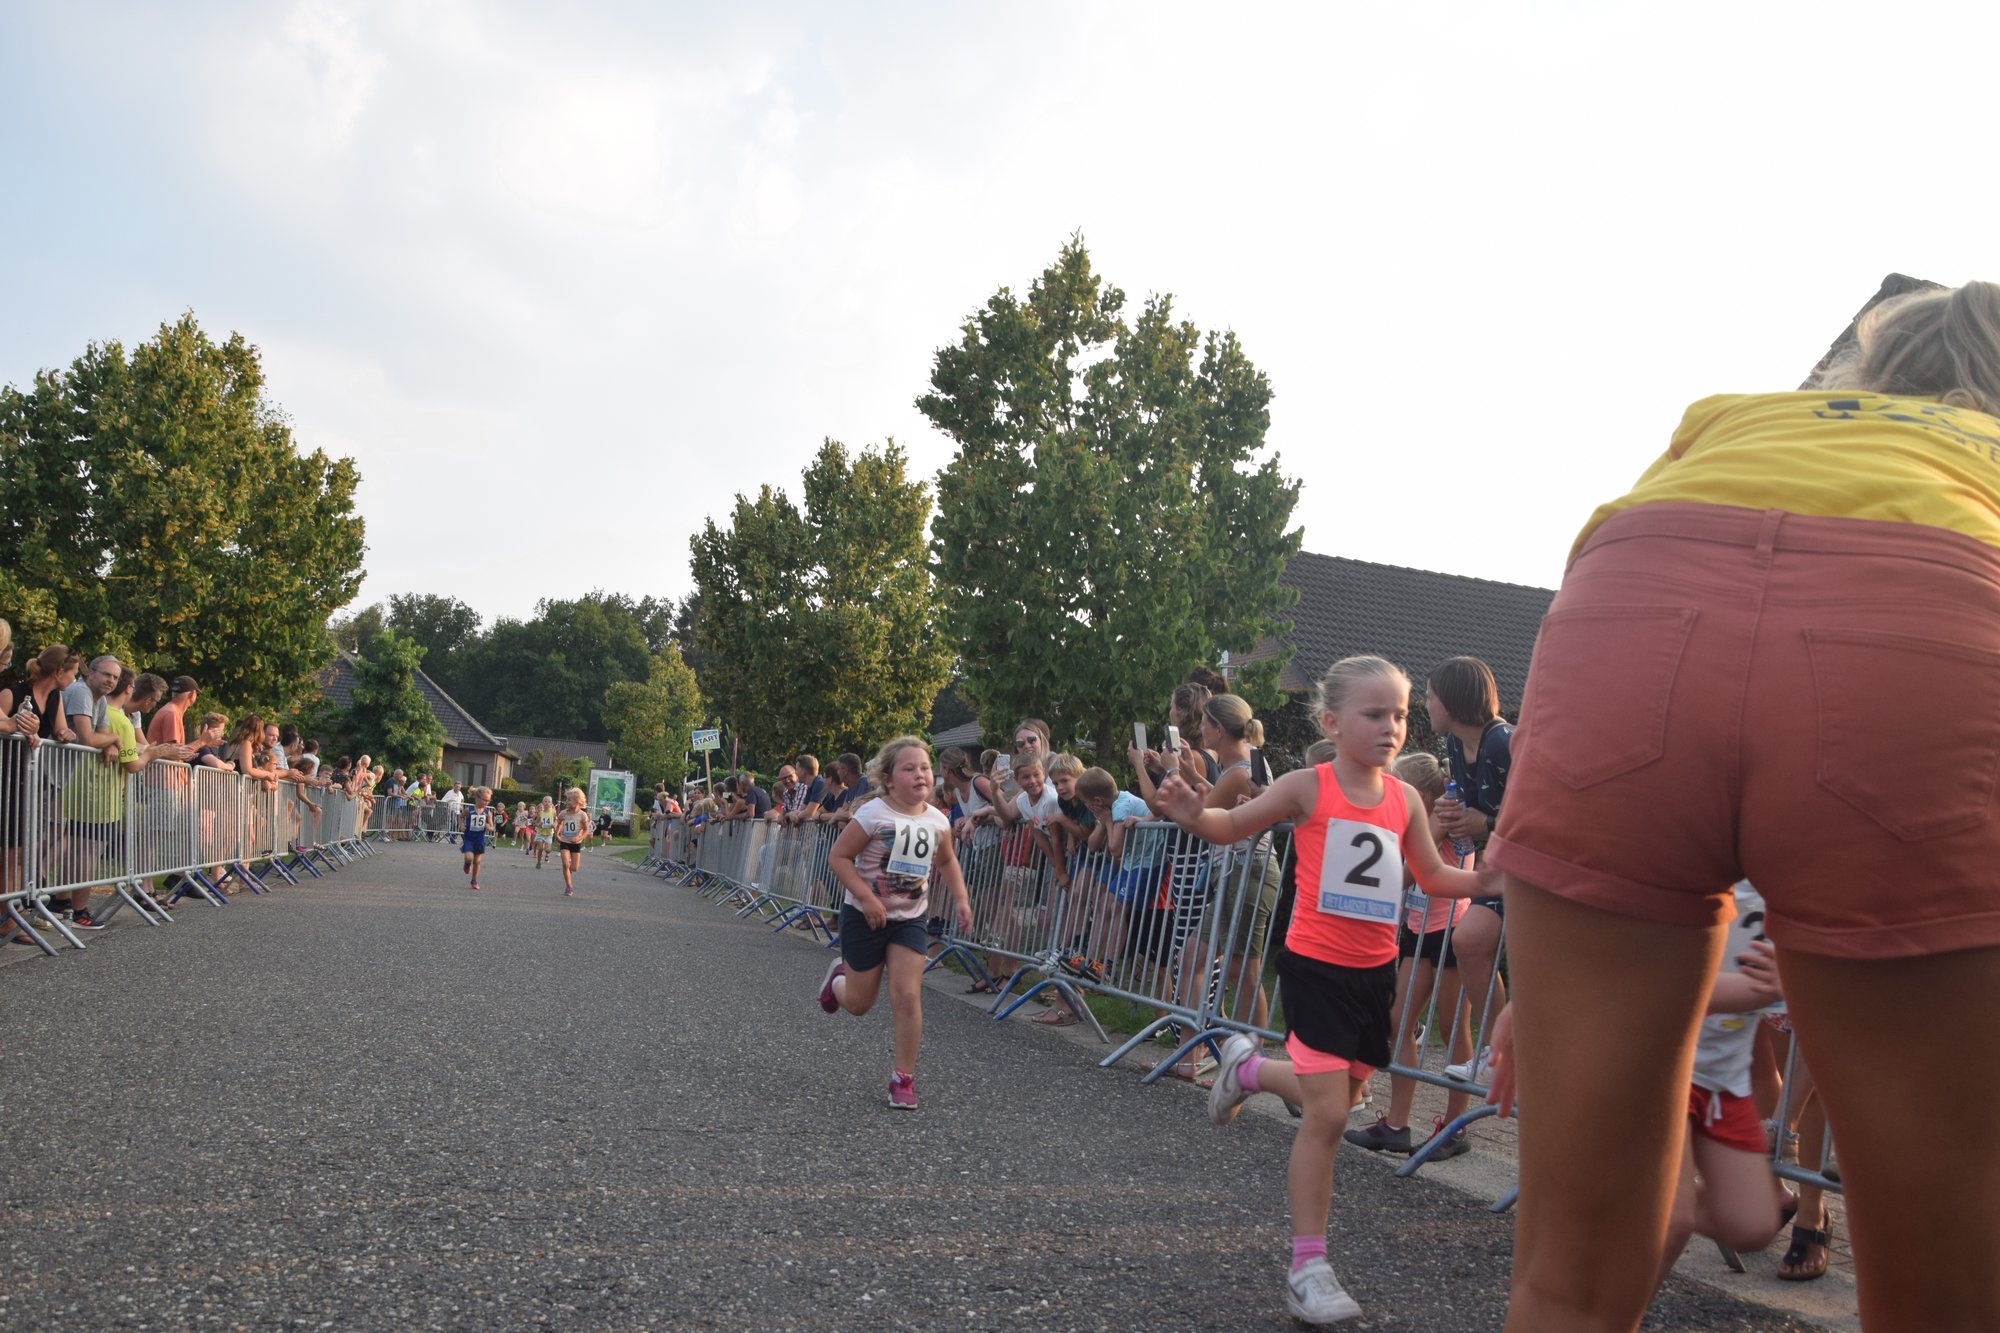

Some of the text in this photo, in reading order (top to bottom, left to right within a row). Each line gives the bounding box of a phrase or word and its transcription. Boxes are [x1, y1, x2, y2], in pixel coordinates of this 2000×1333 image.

[694, 734, 718, 746] START
[471, 816, 484, 827] 15
[542, 817, 551, 825] 14
[565, 822, 576, 832] 10
[900, 824, 930, 859] 18
[1344, 831, 1384, 888] 2
